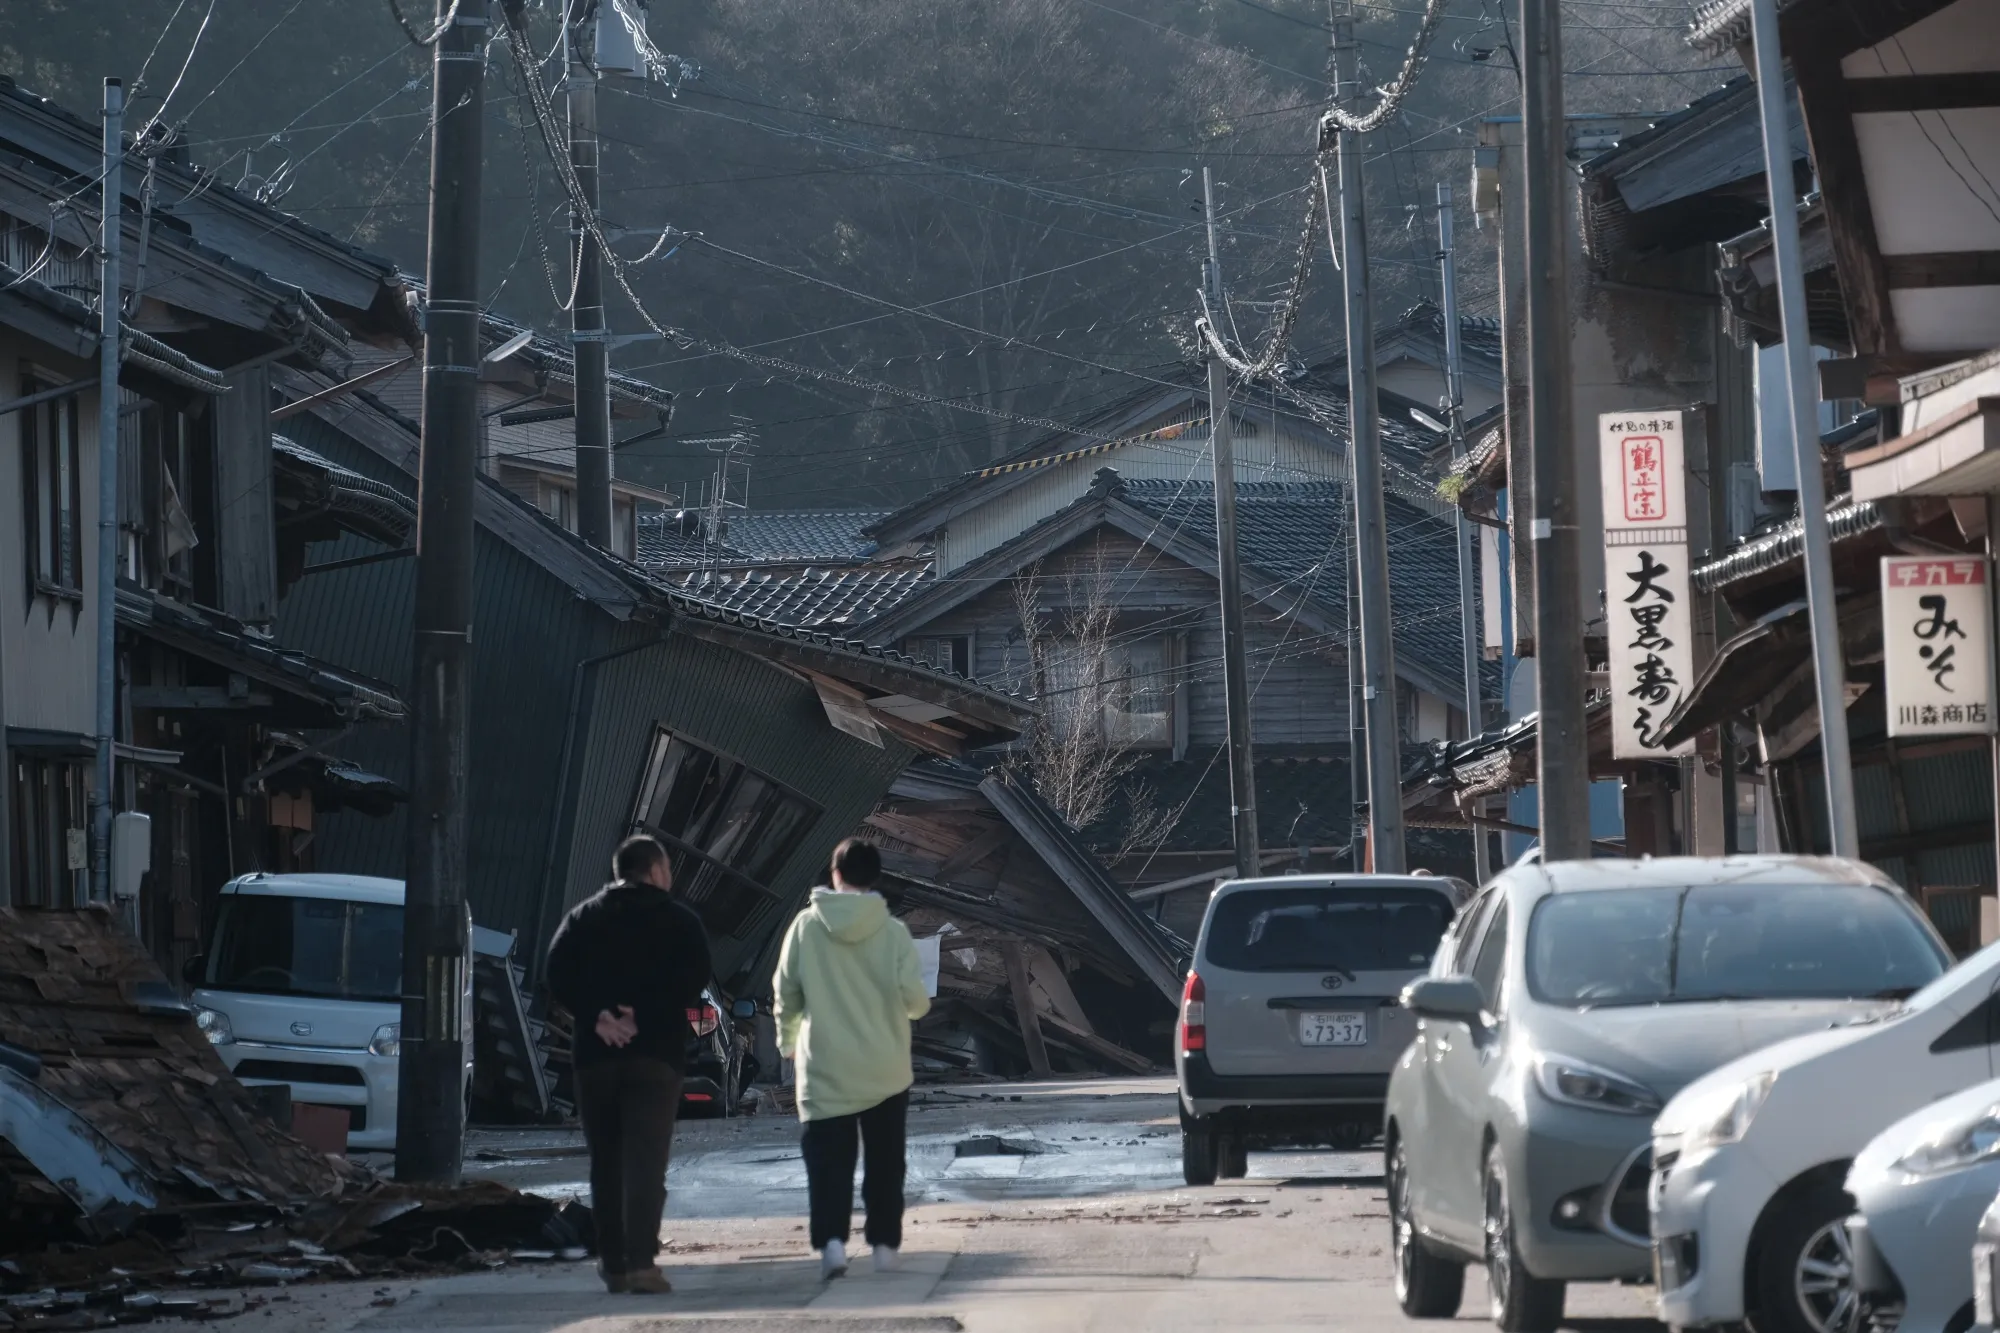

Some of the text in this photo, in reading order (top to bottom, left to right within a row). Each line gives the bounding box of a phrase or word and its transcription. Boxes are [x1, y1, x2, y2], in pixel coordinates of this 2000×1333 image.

[1631, 441, 1658, 516] 鶴正宗
[1897, 563, 1975, 586] チカラ
[1913, 594, 1967, 693] みそ
[1899, 702, 1987, 725] 川森商店
[1315, 1025, 1363, 1042] 73-37
